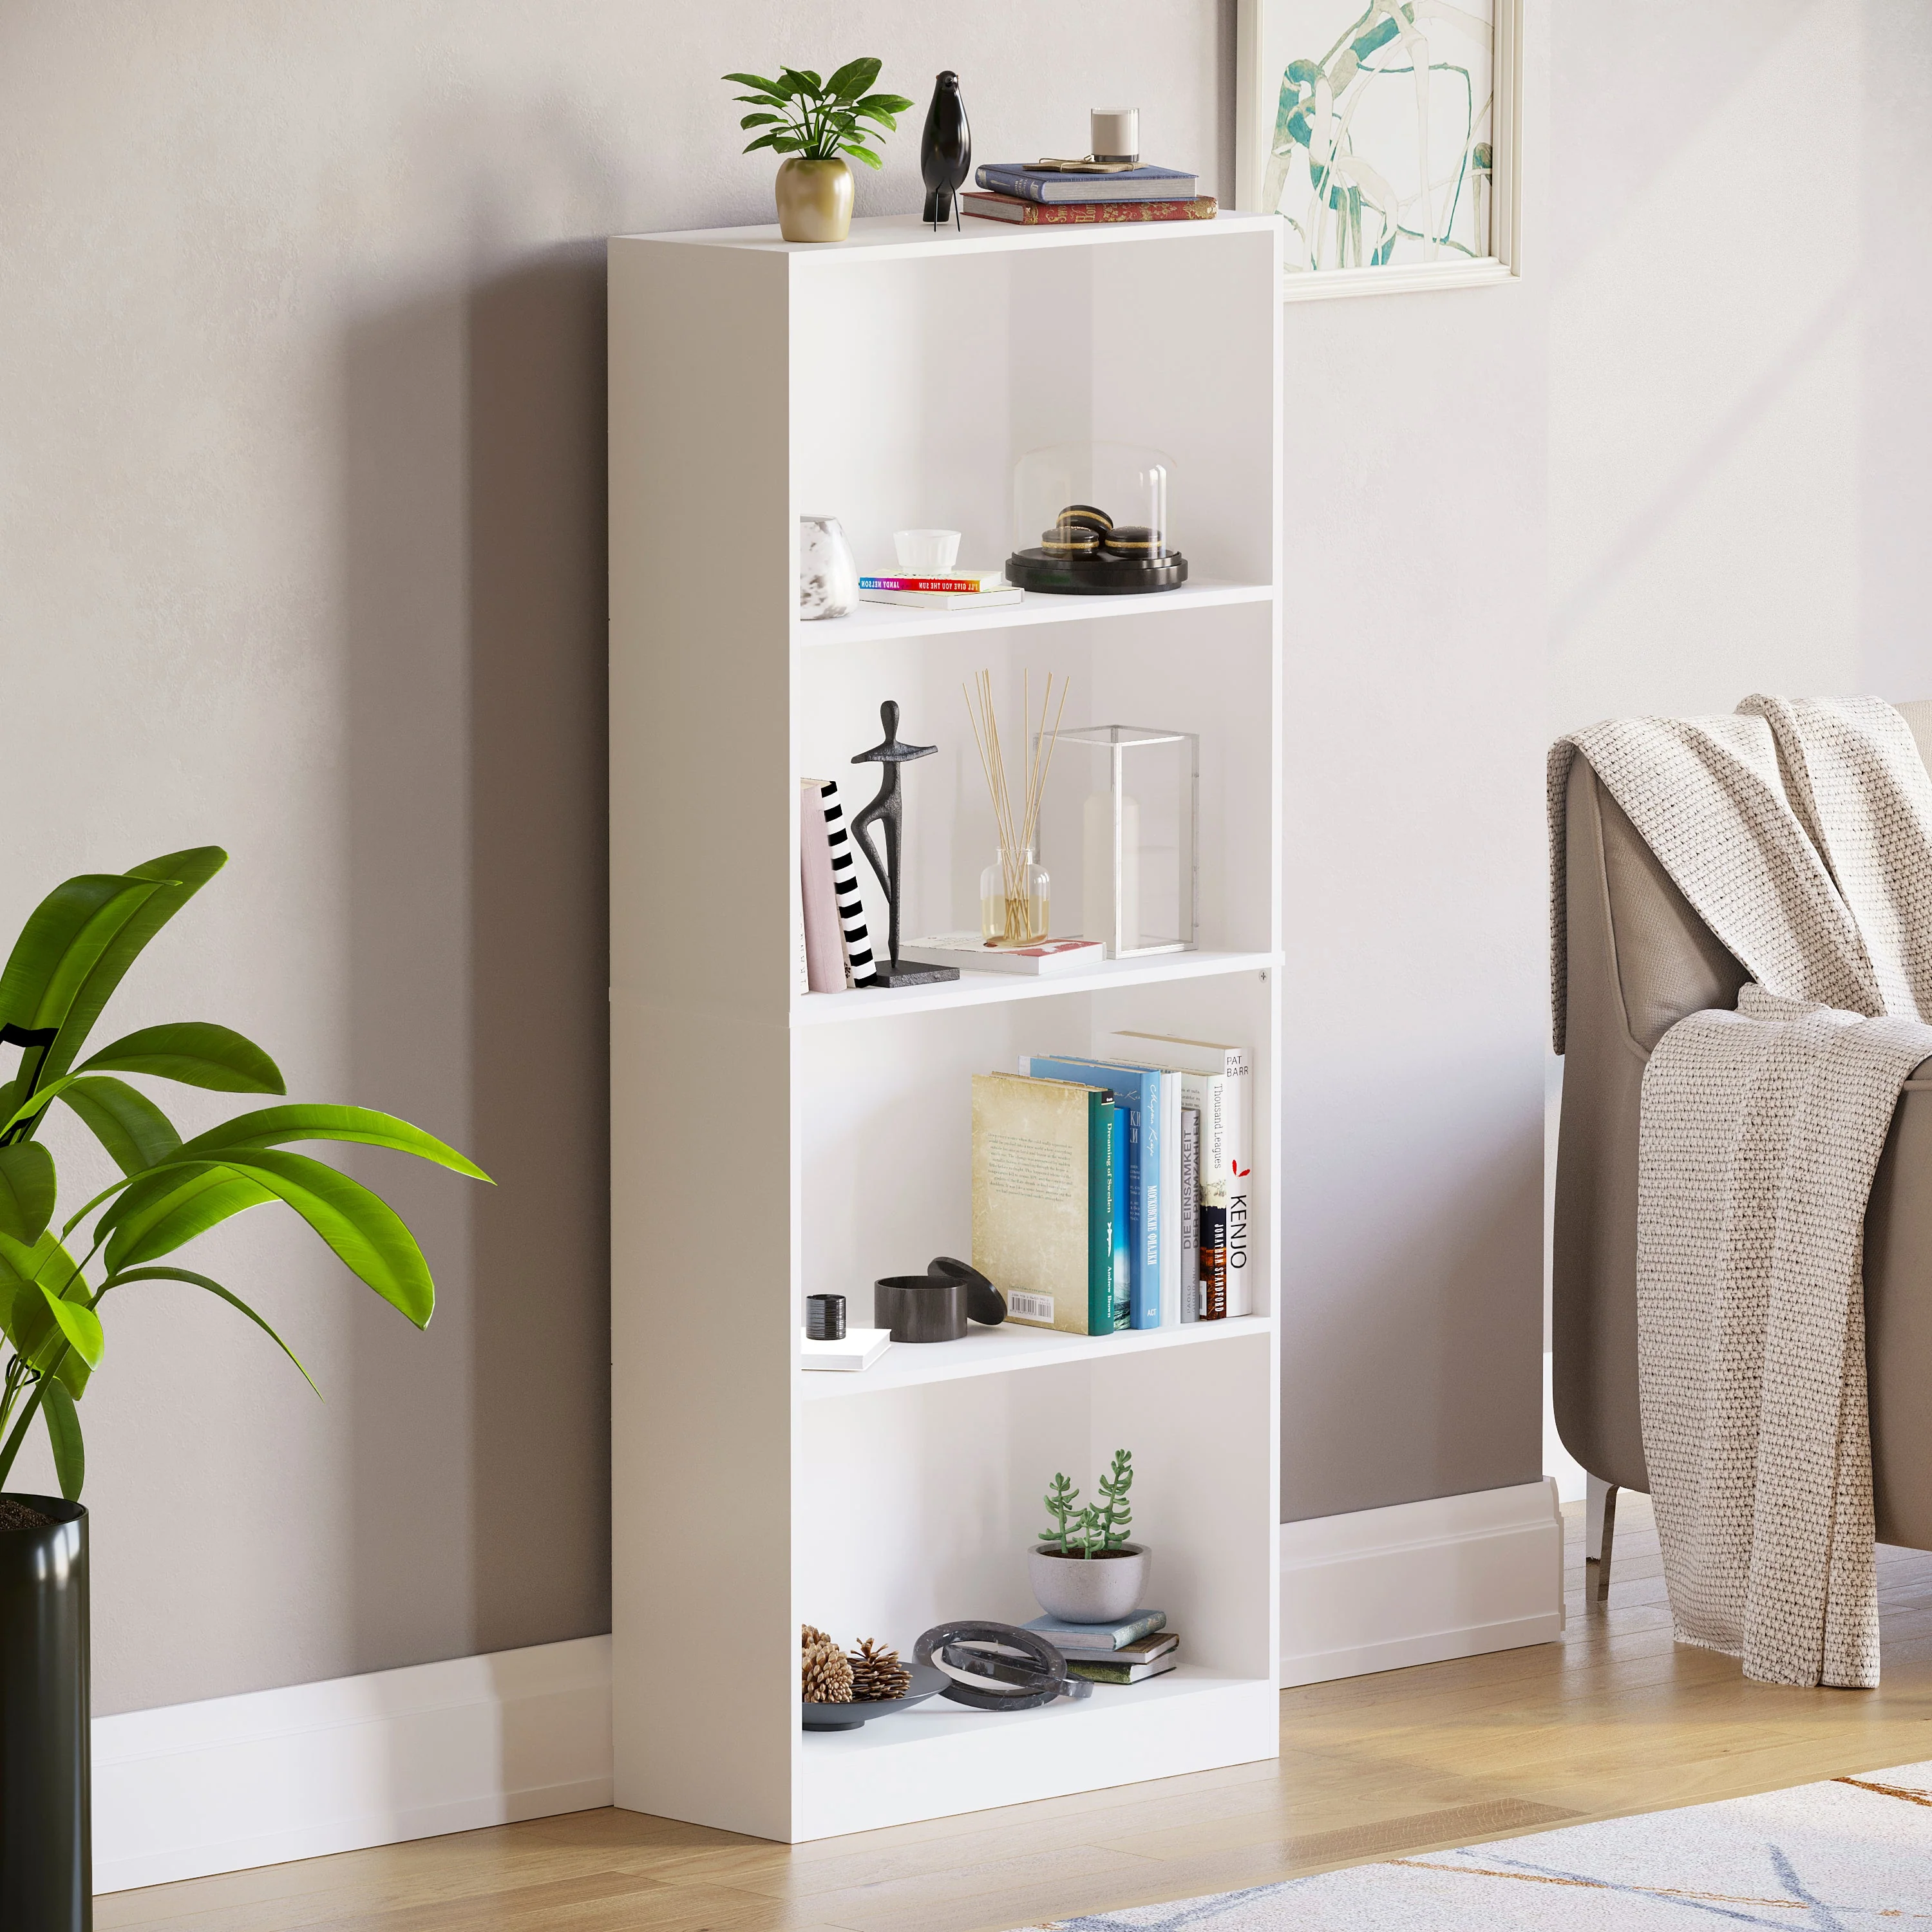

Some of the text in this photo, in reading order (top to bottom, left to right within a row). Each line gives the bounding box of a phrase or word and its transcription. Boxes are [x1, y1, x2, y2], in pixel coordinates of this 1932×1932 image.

[1227, 1056, 1242, 1065] PAT
[1227, 1066, 1248, 1077] BARR
[1212, 1084, 1223, 1169] Thousand Leagues
[1107, 1168, 1113, 1177] of
[1148, 1185, 1157, 1266] МОСКОВСКИЕ ФИАЛКИ
[1230, 1195, 1247, 1269] KENJO
[1214, 1224, 1224, 1312] JONATHAN STANDFORD
